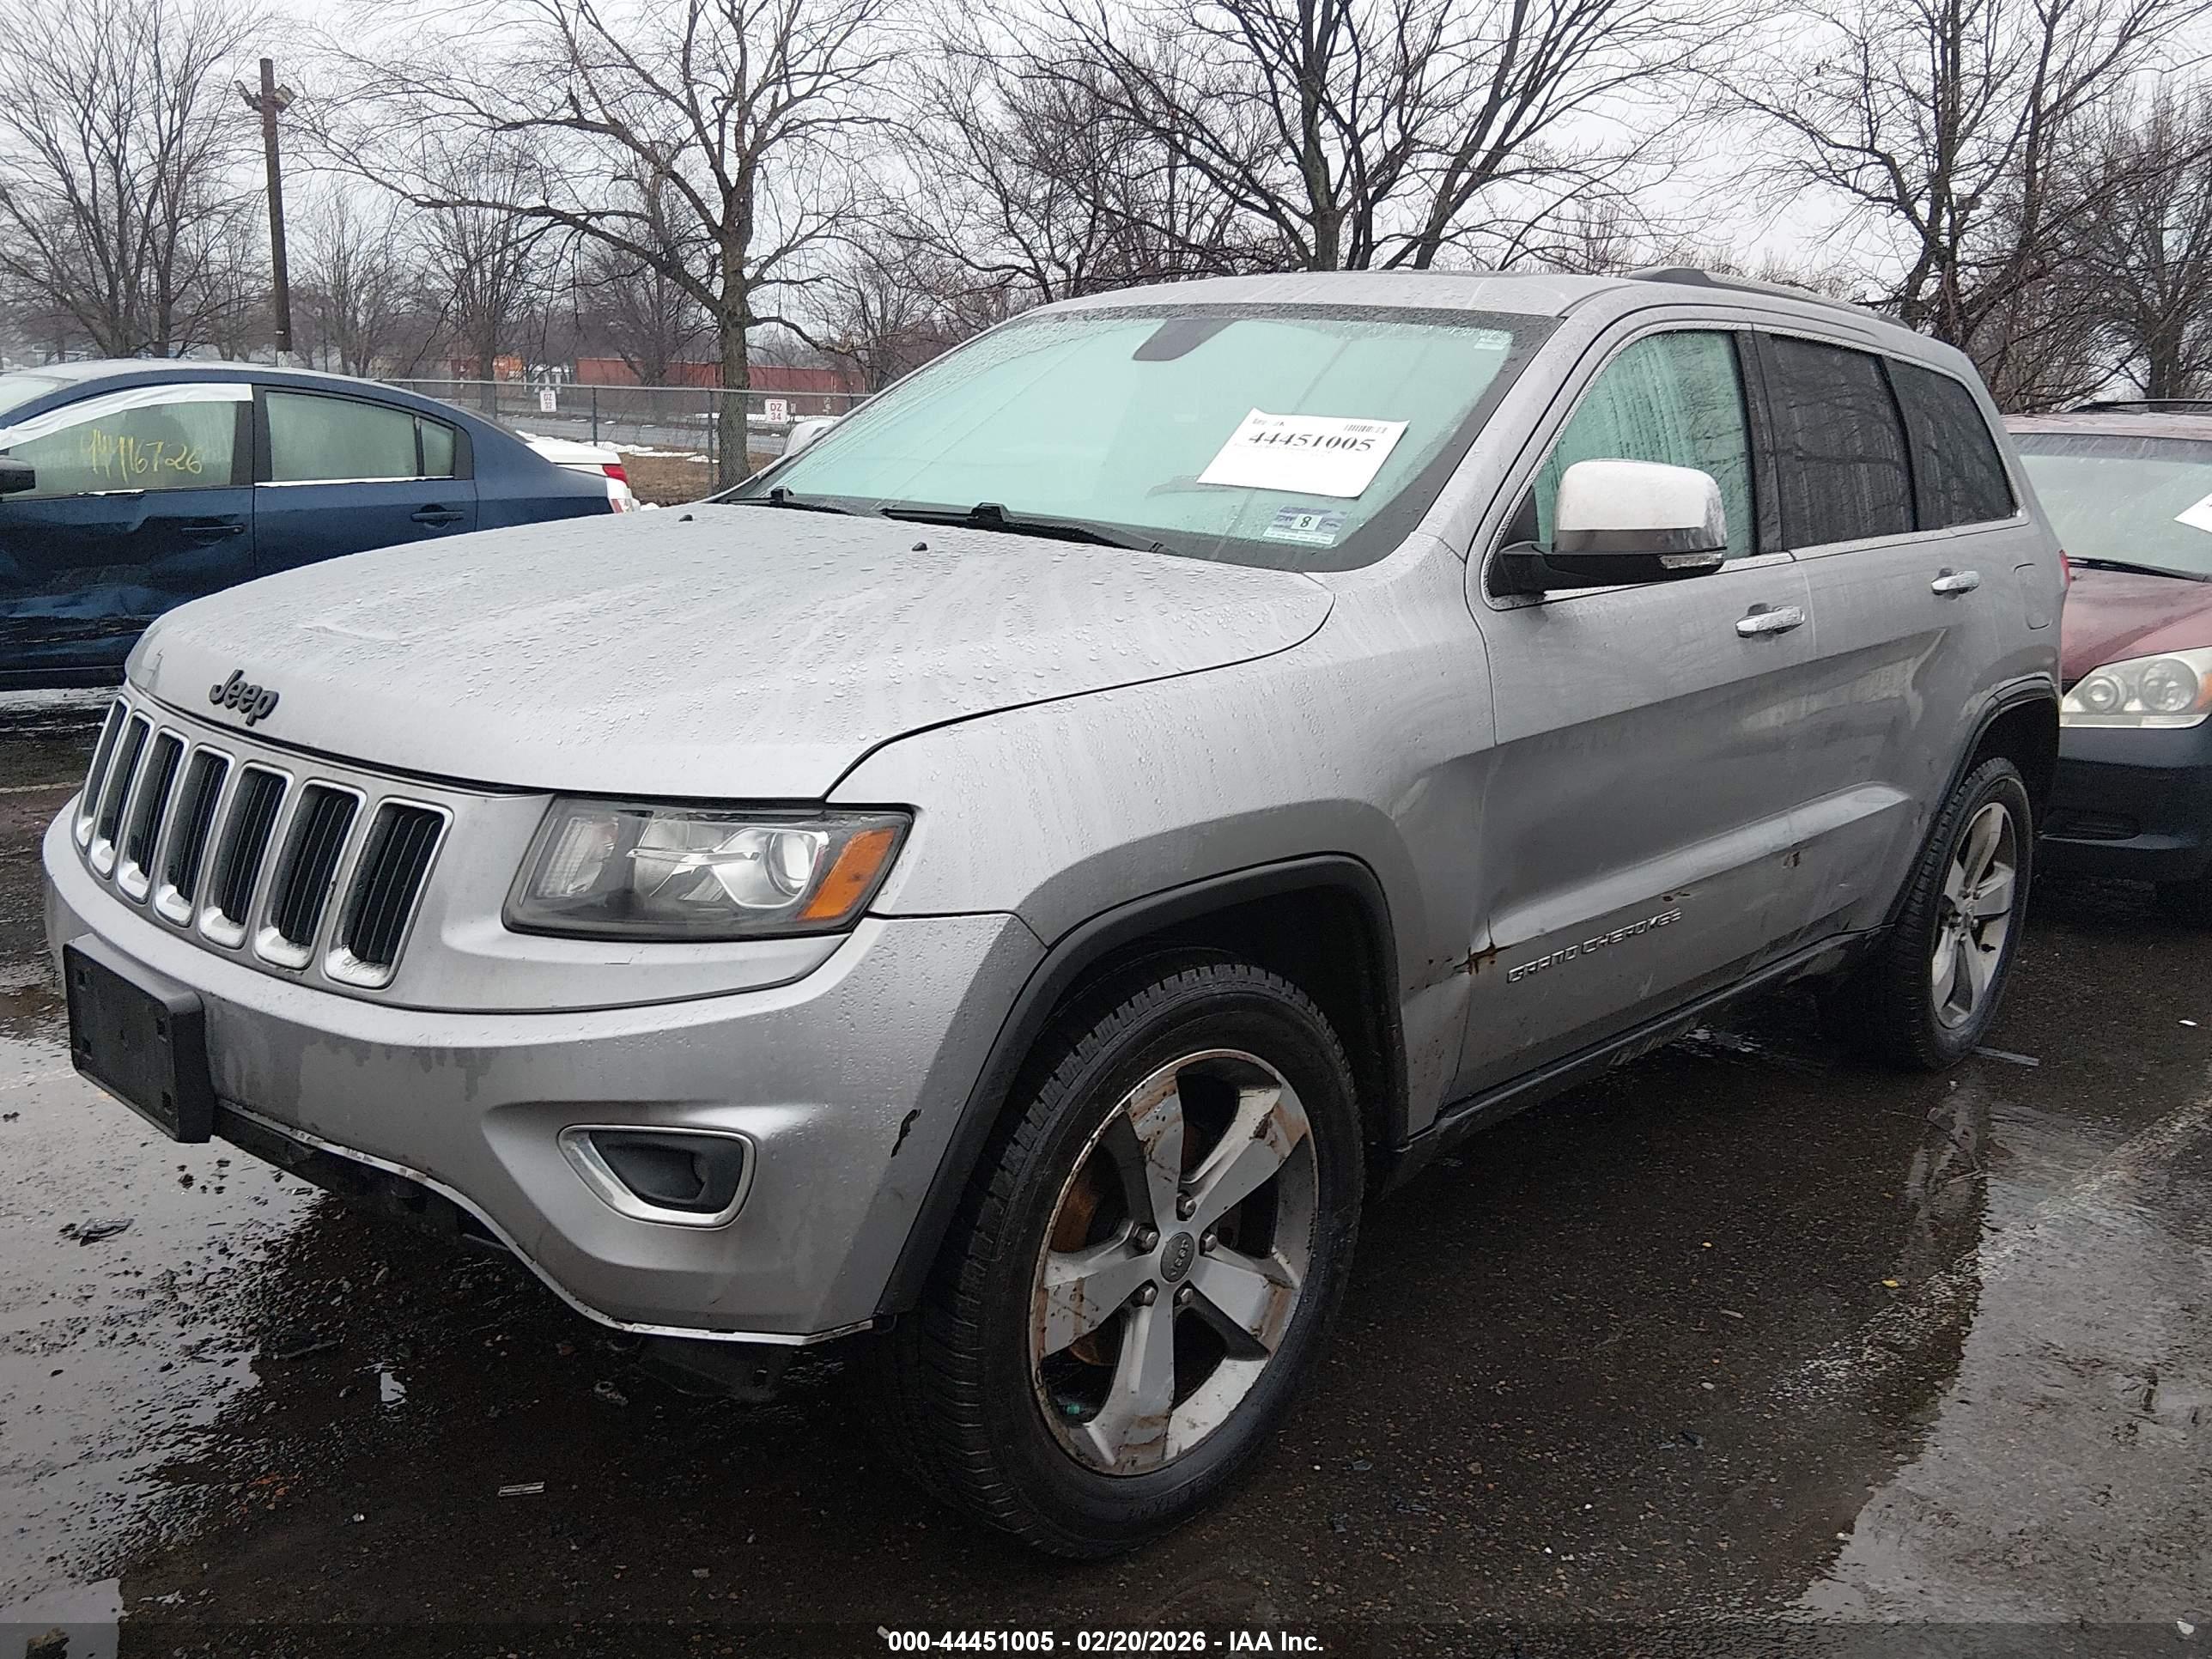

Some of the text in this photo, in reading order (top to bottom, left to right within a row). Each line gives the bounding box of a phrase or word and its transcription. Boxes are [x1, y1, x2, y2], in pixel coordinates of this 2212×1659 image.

[769, 403, 782, 412] DZ
[770, 412, 781, 421] 34
[1249, 432, 1376, 452] 44451005
[1300, 516, 1312, 528] 8
[210, 670, 279, 726] Jeep
[1507, 907, 1682, 983] GRAND CHEROKEE
